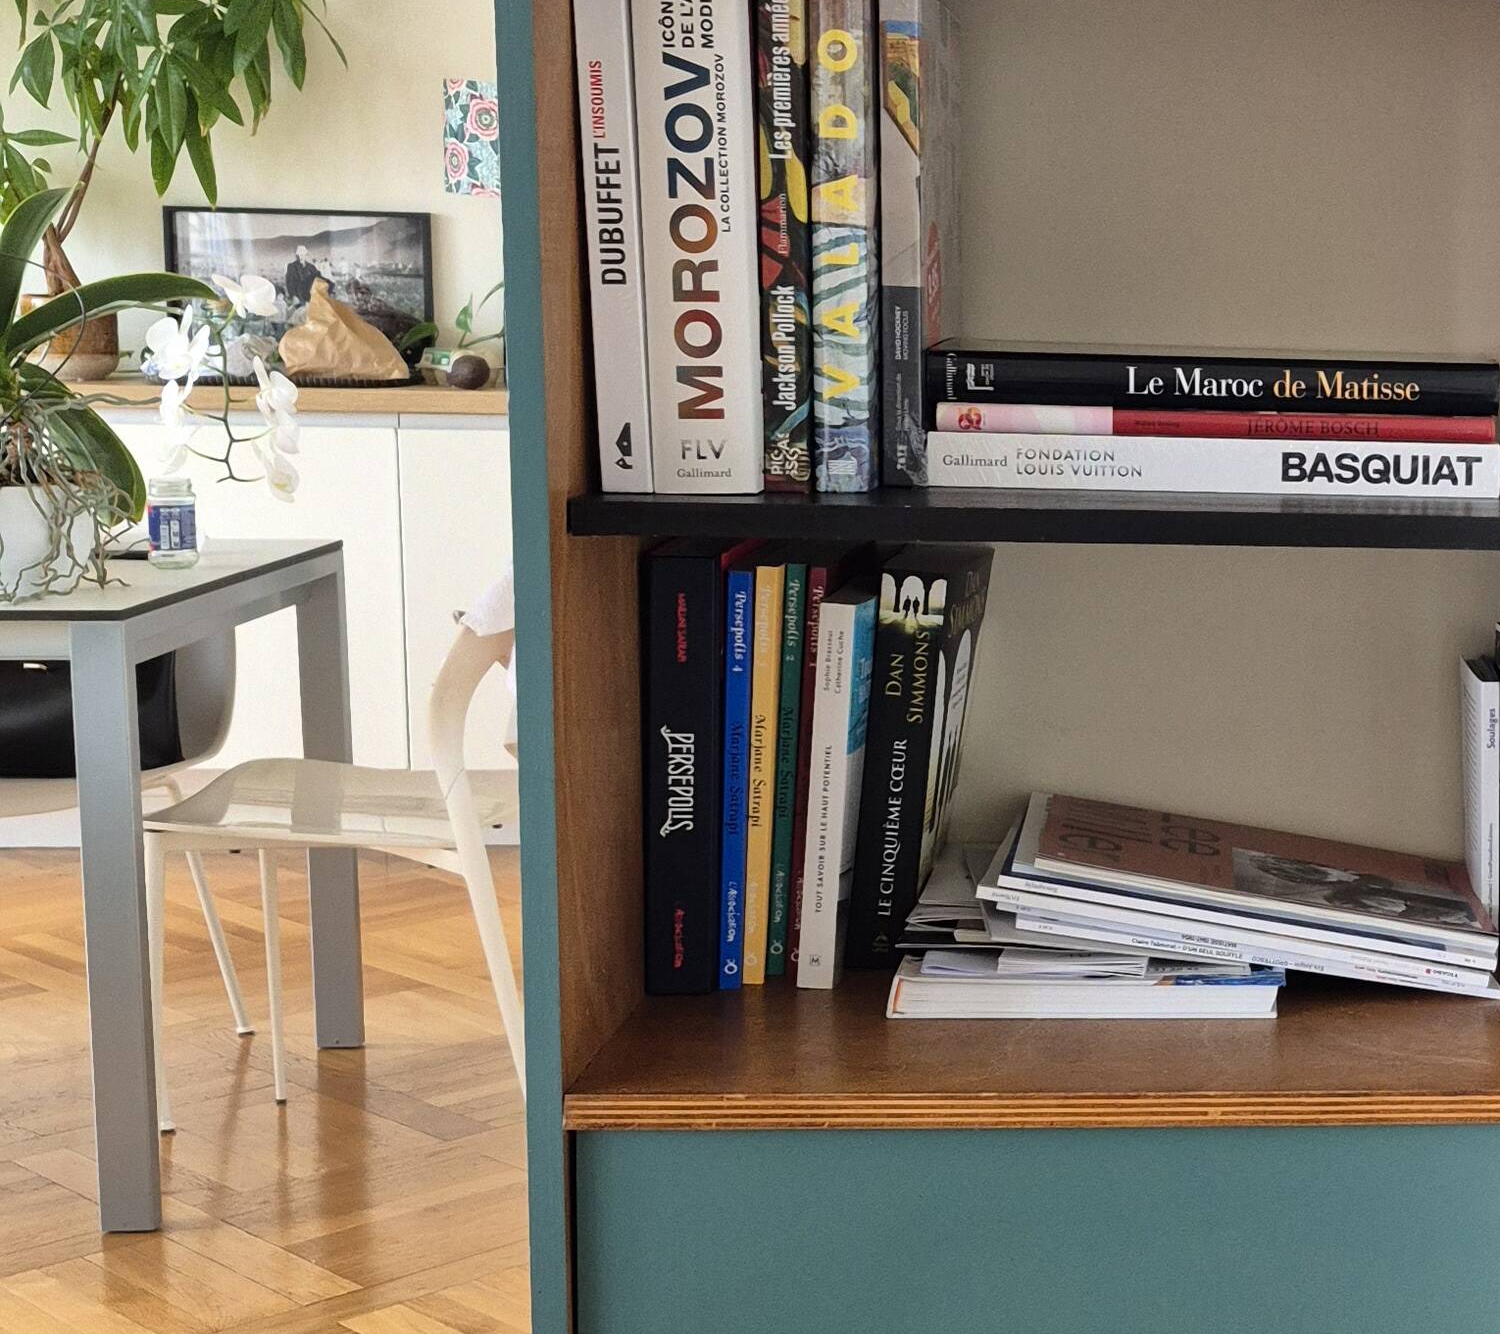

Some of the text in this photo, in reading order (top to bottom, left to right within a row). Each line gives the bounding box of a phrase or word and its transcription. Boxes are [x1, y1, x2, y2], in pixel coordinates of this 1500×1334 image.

[680, 23, 695, 49] DE
[766, 46, 796, 128] premières
[713, 52, 733, 233] LA COLLECTION MOROZOV
[768, 131, 793, 160] Les
[588, 60, 628, 287] DUBUFFET L'INSOUMIS
[661, 50, 726, 421] MOROZOV
[777, 193, 788, 257] Flammarion
[770, 284, 796, 342] Pollock
[771, 345, 798, 411] Jackson
[1123, 364, 1422, 402] Le Maroc de Matisse
[680, 438, 729, 461] FLV
[1015, 448, 1115, 463] FONDATION
[1246, 417, 1380, 436] JÉRÔME BOSCH
[676, 467, 733, 479] Gallimard
[942, 454, 1009, 468] Gallimard
[1015, 463, 1142, 478] LOUIS VUITTON
[1280, 451, 1483, 487] BASQUIAT
[777, 578, 801, 819] Persepolis Marjane Satrapi
[823, 665, 832, 692] Sophie
[884, 653, 906, 697] DAN
[905, 627, 932, 725] SIMMONS
[727, 590, 748, 836] Persepolis Marjane Satrapi
[1486, 707, 1498, 750] Soulages
[659, 723, 695, 838] PERSEPOLIS
[750, 714, 767, 828] Marjane Satrapi
[814, 744, 834, 914] TOUT SAVOIR SUR LE HAUT POTENTIEL
[876, 738, 908, 917] LE CINQUIÈME CŒUR
